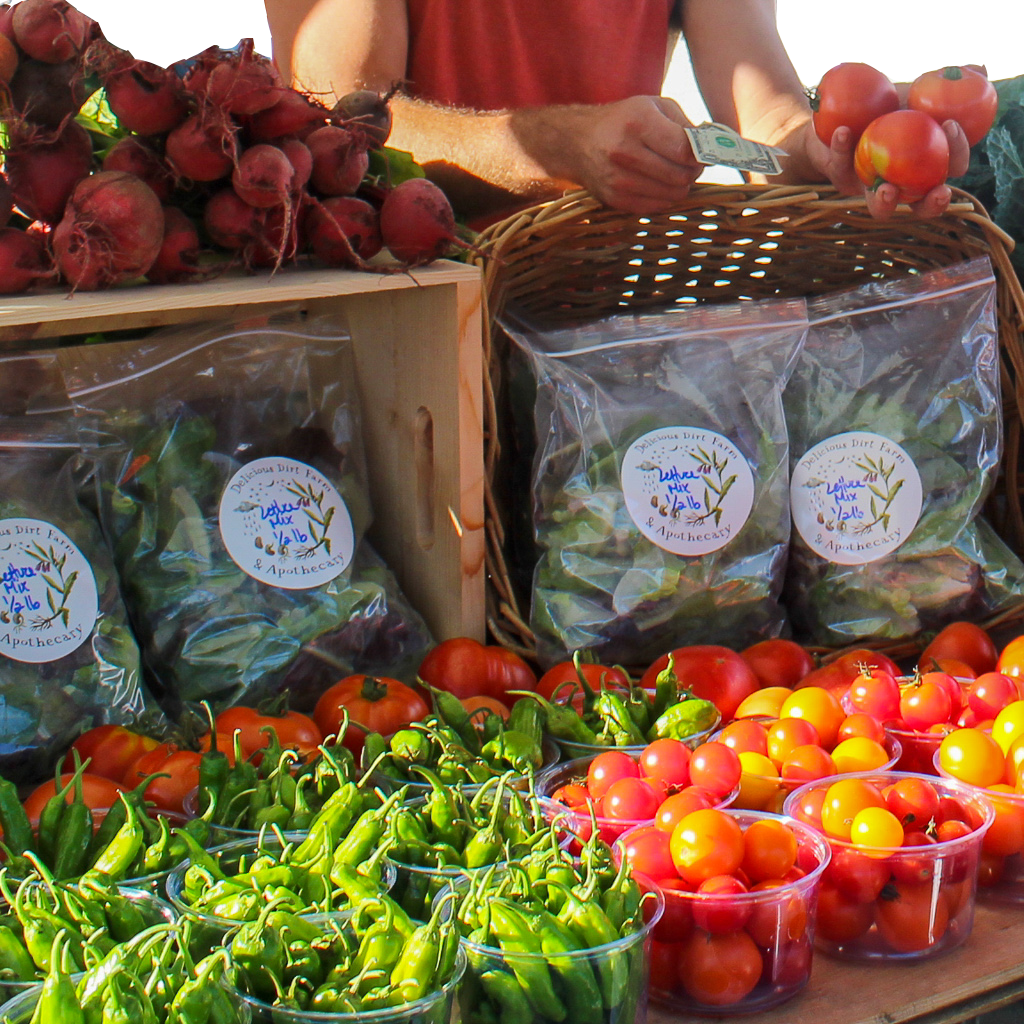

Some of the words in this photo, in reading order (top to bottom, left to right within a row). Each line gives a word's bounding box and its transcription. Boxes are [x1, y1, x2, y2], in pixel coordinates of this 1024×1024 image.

[634, 434, 678, 454] Delicious
[684, 432, 706, 441] Dirt
[712, 437, 738, 459] Farm
[802, 442, 846, 470] Delicious
[852, 439, 874, 448] Dirt
[880, 442, 905, 464] Farm
[231, 464, 274, 494] Delicious
[277, 464, 299, 474] Dirt
[305, 469, 332, 492] Farm
[16, 526, 40, 535] Dirt
[48, 530, 75, 554] Farm
[646, 517, 654, 528] &
[656, 524, 732, 542] Apothecary
[814, 534, 822, 544] &
[825, 527, 902, 553] Apothecary
[1, 563, 36, 582] ettuce
[254, 559, 262, 570] &
[266, 552, 344, 578] Apothecary
[1, 624, 83, 648] Apothecary
